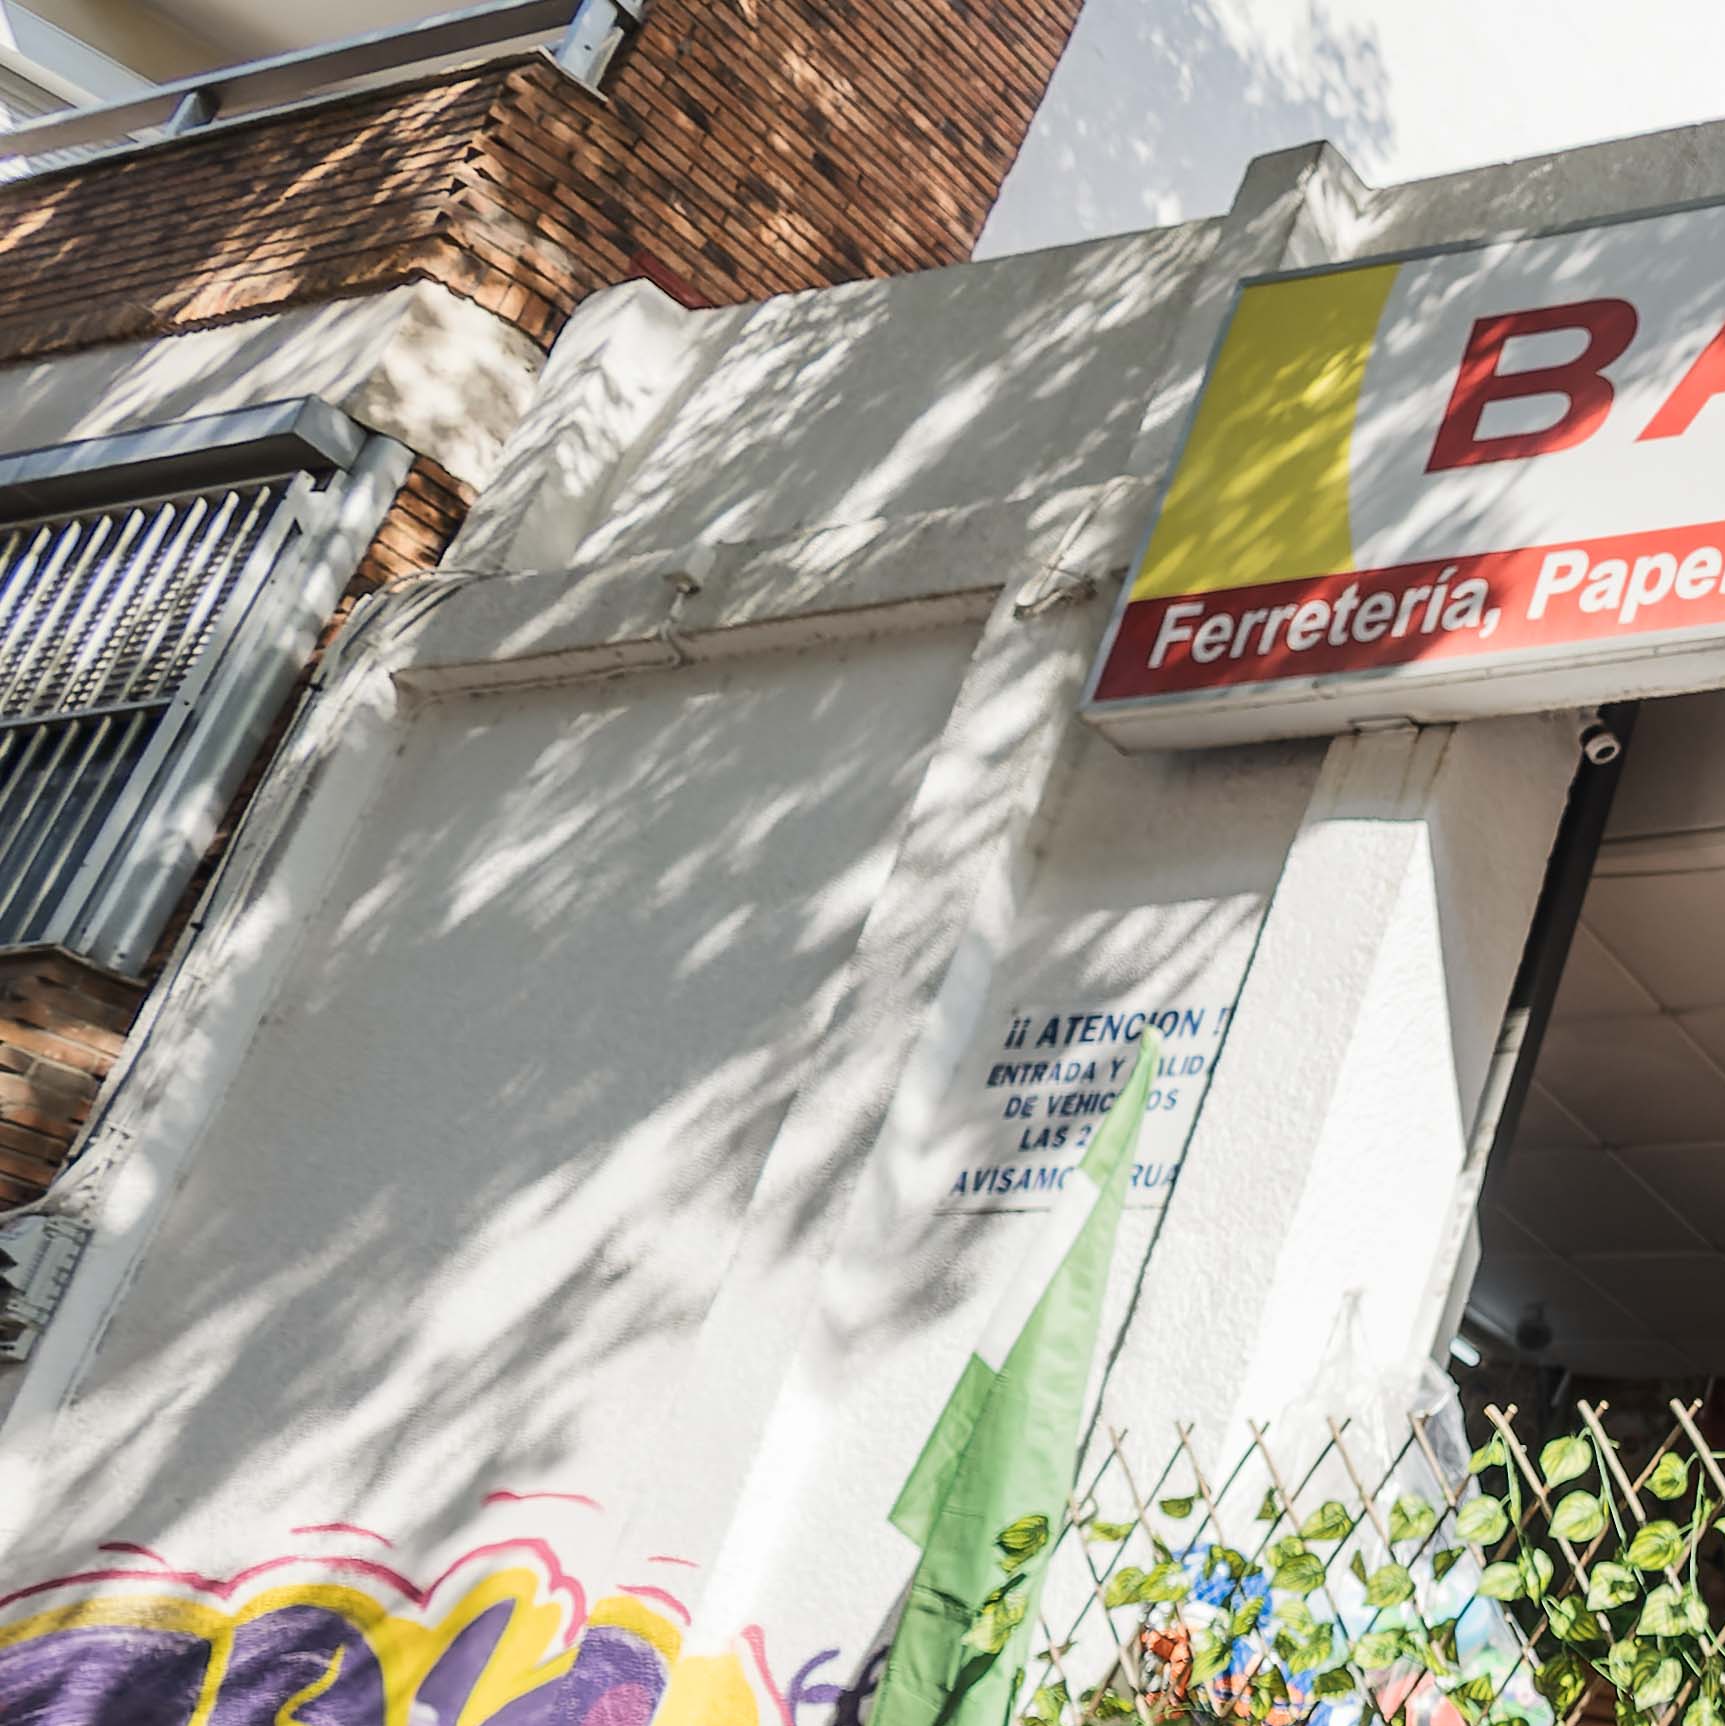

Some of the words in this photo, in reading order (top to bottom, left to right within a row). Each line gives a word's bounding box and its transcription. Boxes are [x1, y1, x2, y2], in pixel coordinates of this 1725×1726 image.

[1147, 565, 1502, 670] Ferretería,
[986, 1059, 1097, 1088] ENTRADA
[1109, 1056, 1125, 1080] Y
[1004, 1096, 1038, 1119] DE
[1047, 1088, 1180, 1116] VEHICOS
[1018, 1125, 1069, 1152] LAS
